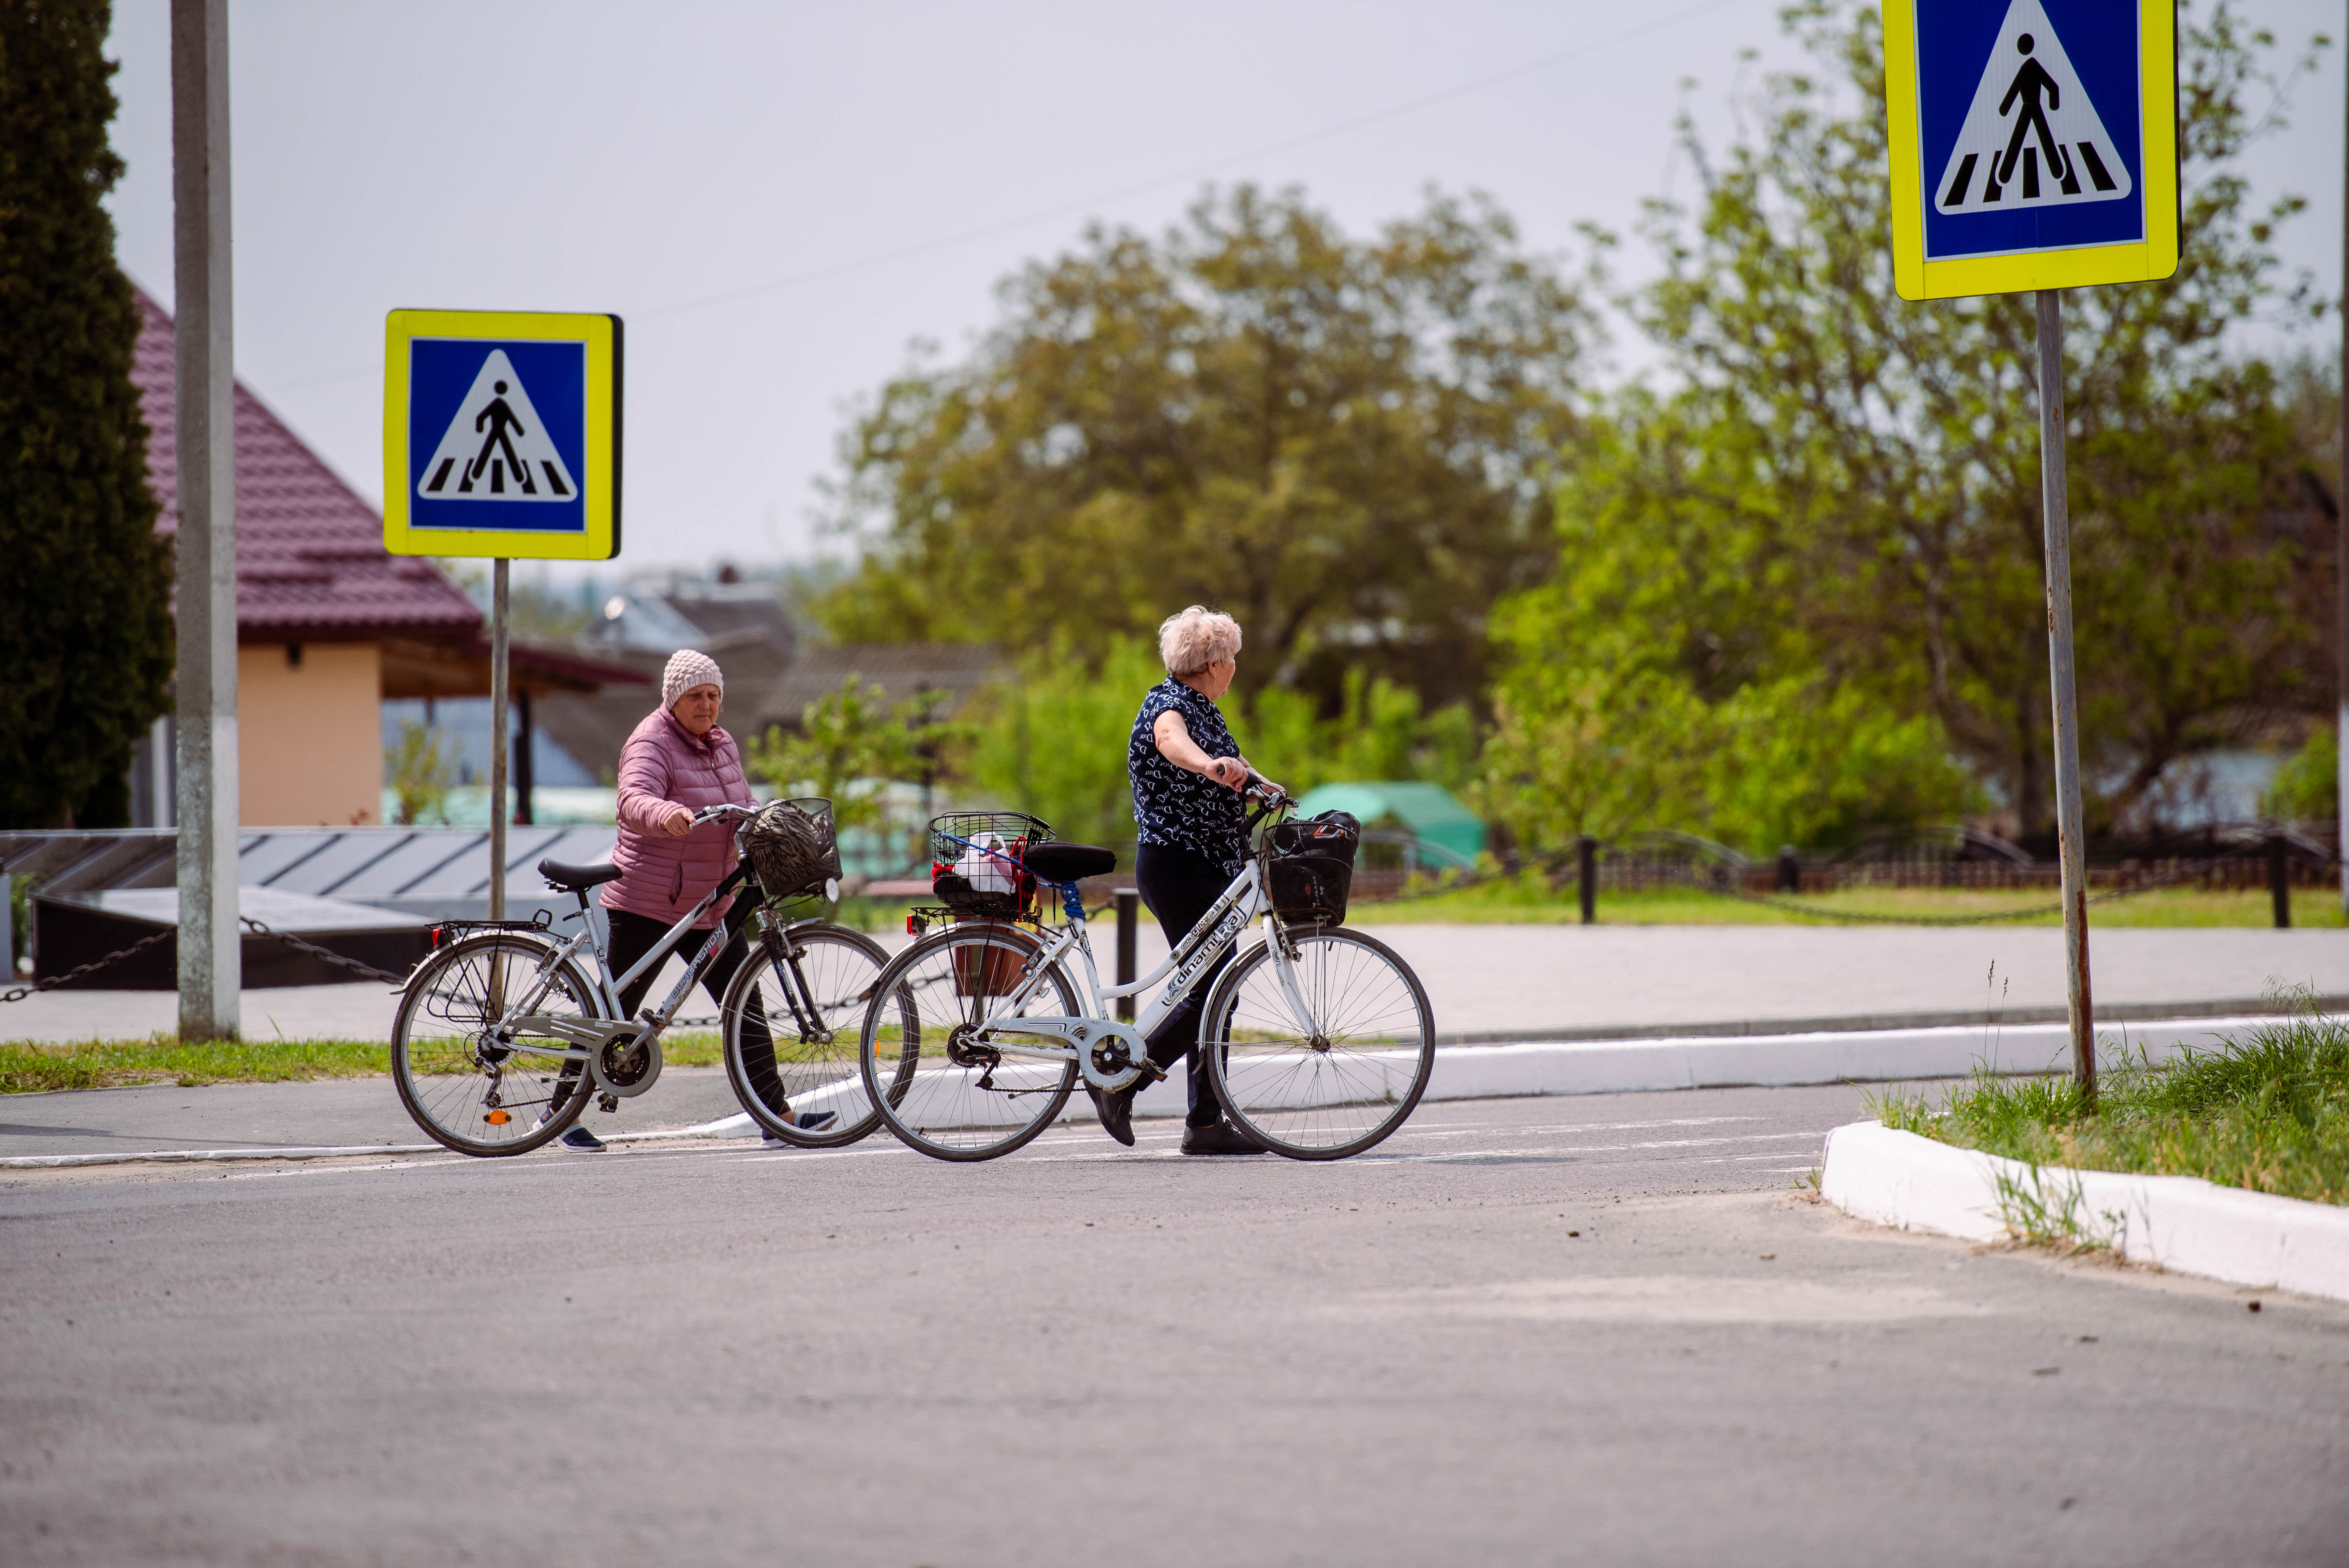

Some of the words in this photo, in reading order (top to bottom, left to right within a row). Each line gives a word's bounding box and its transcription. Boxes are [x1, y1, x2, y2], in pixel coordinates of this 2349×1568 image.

[1140, 734, 1154, 743] Dior
[1134, 741, 1148, 755] Dior
[1130, 759, 1142, 770] Dior
[1147, 754, 1161, 768] Dior
[1145, 770, 1162, 779] Dior
[1140, 777, 1156, 791] Dior
[1177, 783, 1195, 793] Dior
[1156, 790, 1171, 804] Dior
[1202, 786, 1218, 798] Dior
[1227, 793, 1240, 801] Dior
[1139, 794, 1151, 805] Dior
[1197, 798, 1216, 811] Dior
[1155, 805, 1174, 814] Dior
[1149, 812, 1166, 825] Dior
[1176, 809, 1191, 826] Dior
[671, 925, 724, 999] BLACKSHOX
